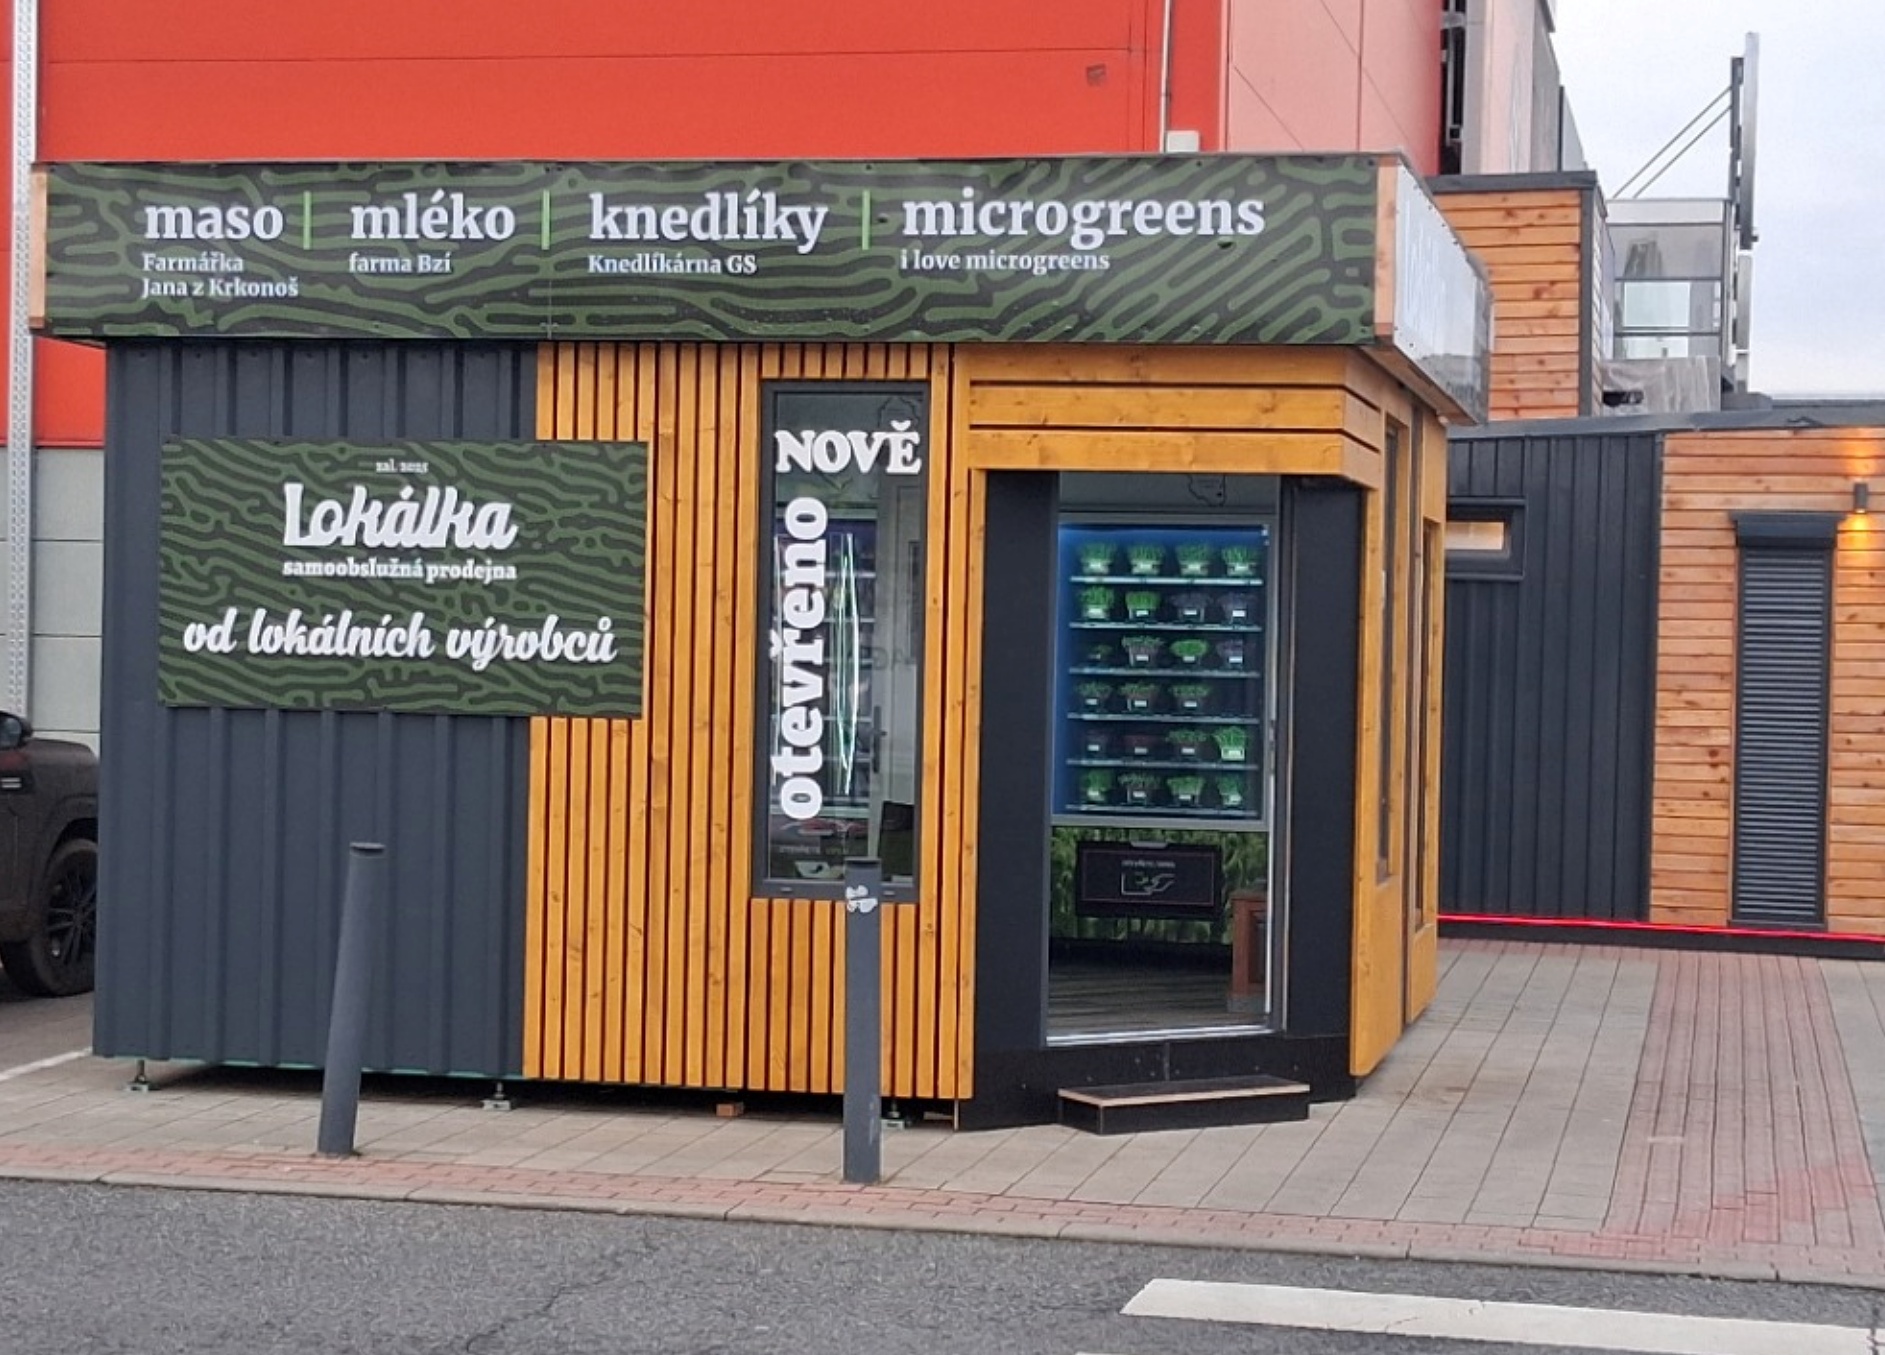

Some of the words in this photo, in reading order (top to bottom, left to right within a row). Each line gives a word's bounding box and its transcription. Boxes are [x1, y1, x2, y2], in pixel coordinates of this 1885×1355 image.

[144, 204, 284, 240] maso
[350, 189, 516, 240] mléko
[588, 189, 829, 254] knedlíky
[903, 186, 1266, 251] microgreens
[141, 251, 244, 272] Farmářka
[348, 251, 413, 273] farma
[417, 250, 452, 273] Bzí
[587, 250, 722, 274] Knedlíkárna
[725, 254, 758, 274] GS
[900, 249, 908, 270] i
[914, 249, 961, 270] love
[966, 248, 1111, 275] microgreens
[141, 277, 189, 300] Jana
[191, 281, 205, 297] z
[208, 276, 300, 297] Krkonoš
[774, 419, 922, 475] NOVĚ
[282, 482, 520, 551] Lokálka
[282, 556, 424, 579] samoobslužná
[425, 558, 518, 585] prodejna
[182, 606, 238, 655] od
[247, 607, 436, 660] lokálních
[445, 614, 618, 673] výrobců
[768, 496, 830, 820] otevřeno
